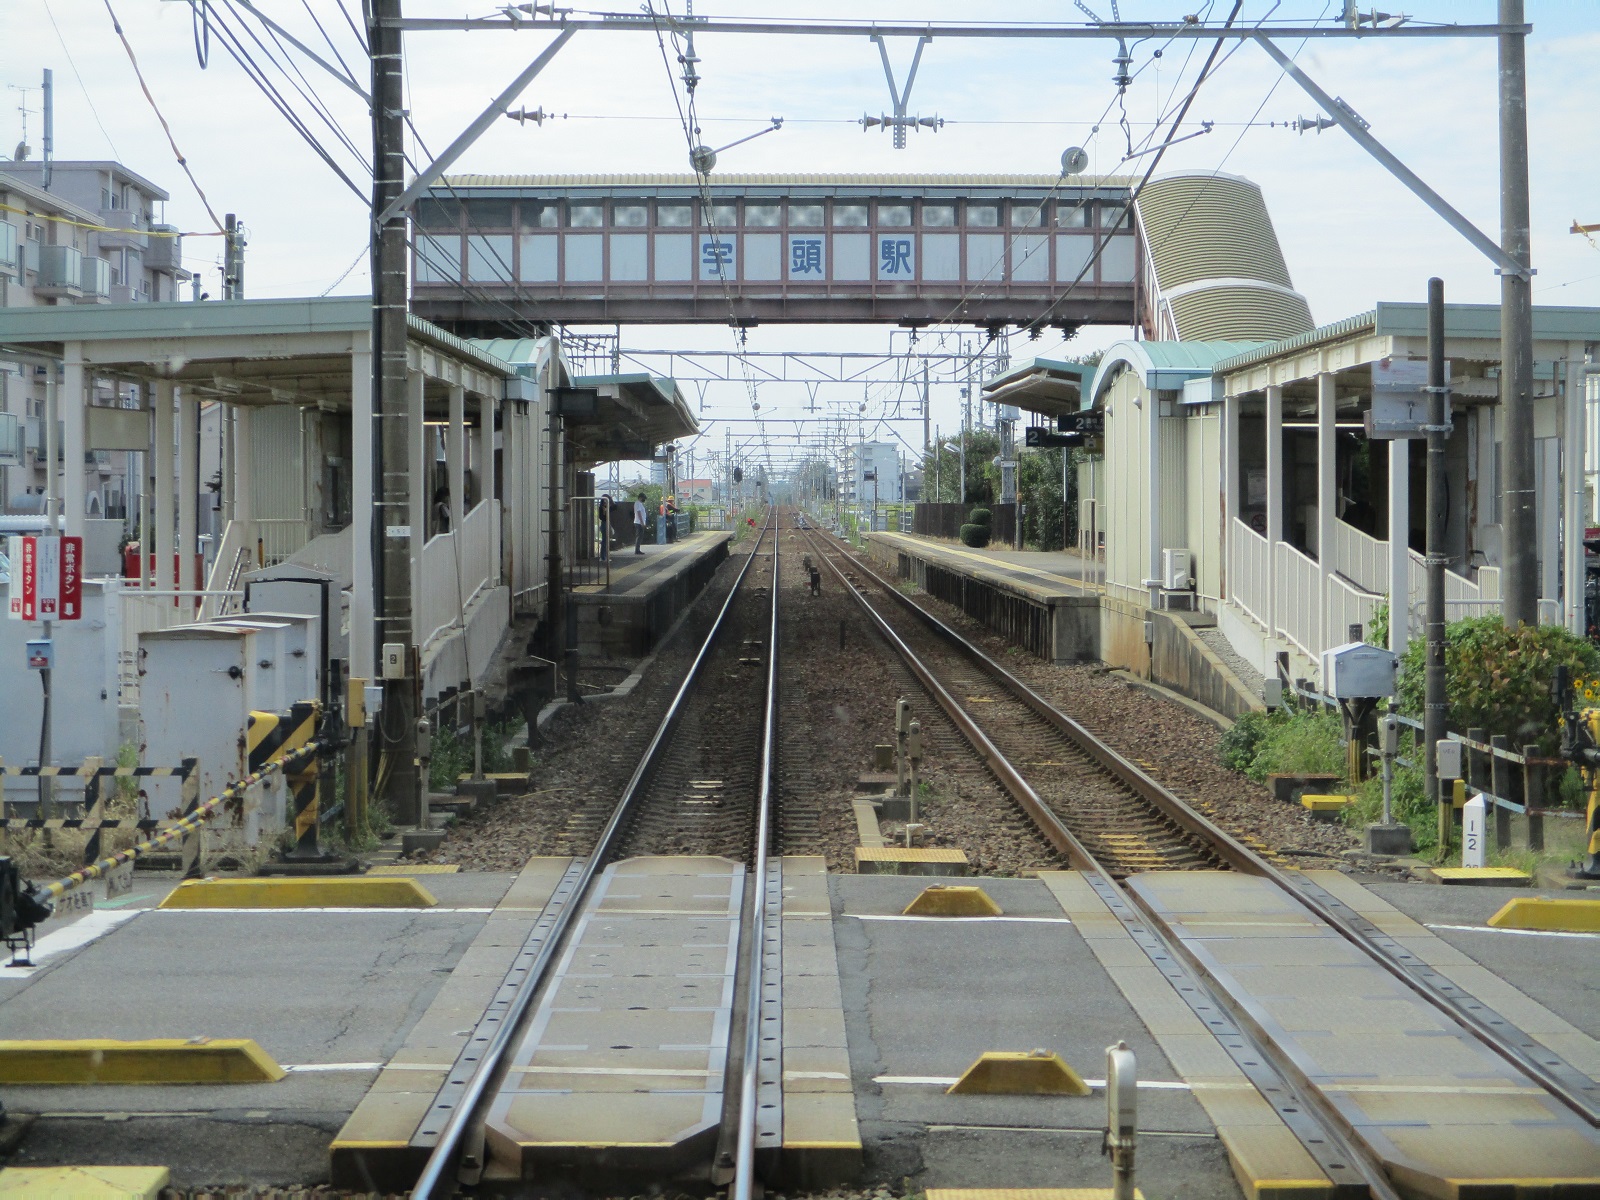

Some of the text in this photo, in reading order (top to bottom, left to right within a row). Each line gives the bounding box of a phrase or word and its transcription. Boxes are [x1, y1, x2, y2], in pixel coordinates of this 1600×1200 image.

[703, 239, 911, 274] 宇頭駅
[1076, 418, 1084, 430] 2
[1028, 431, 1038, 443] 2
[65, 542, 75, 595] 非常ボタン
[390, 655, 396, 664] 2
[1468, 838, 1477, 851] 2
